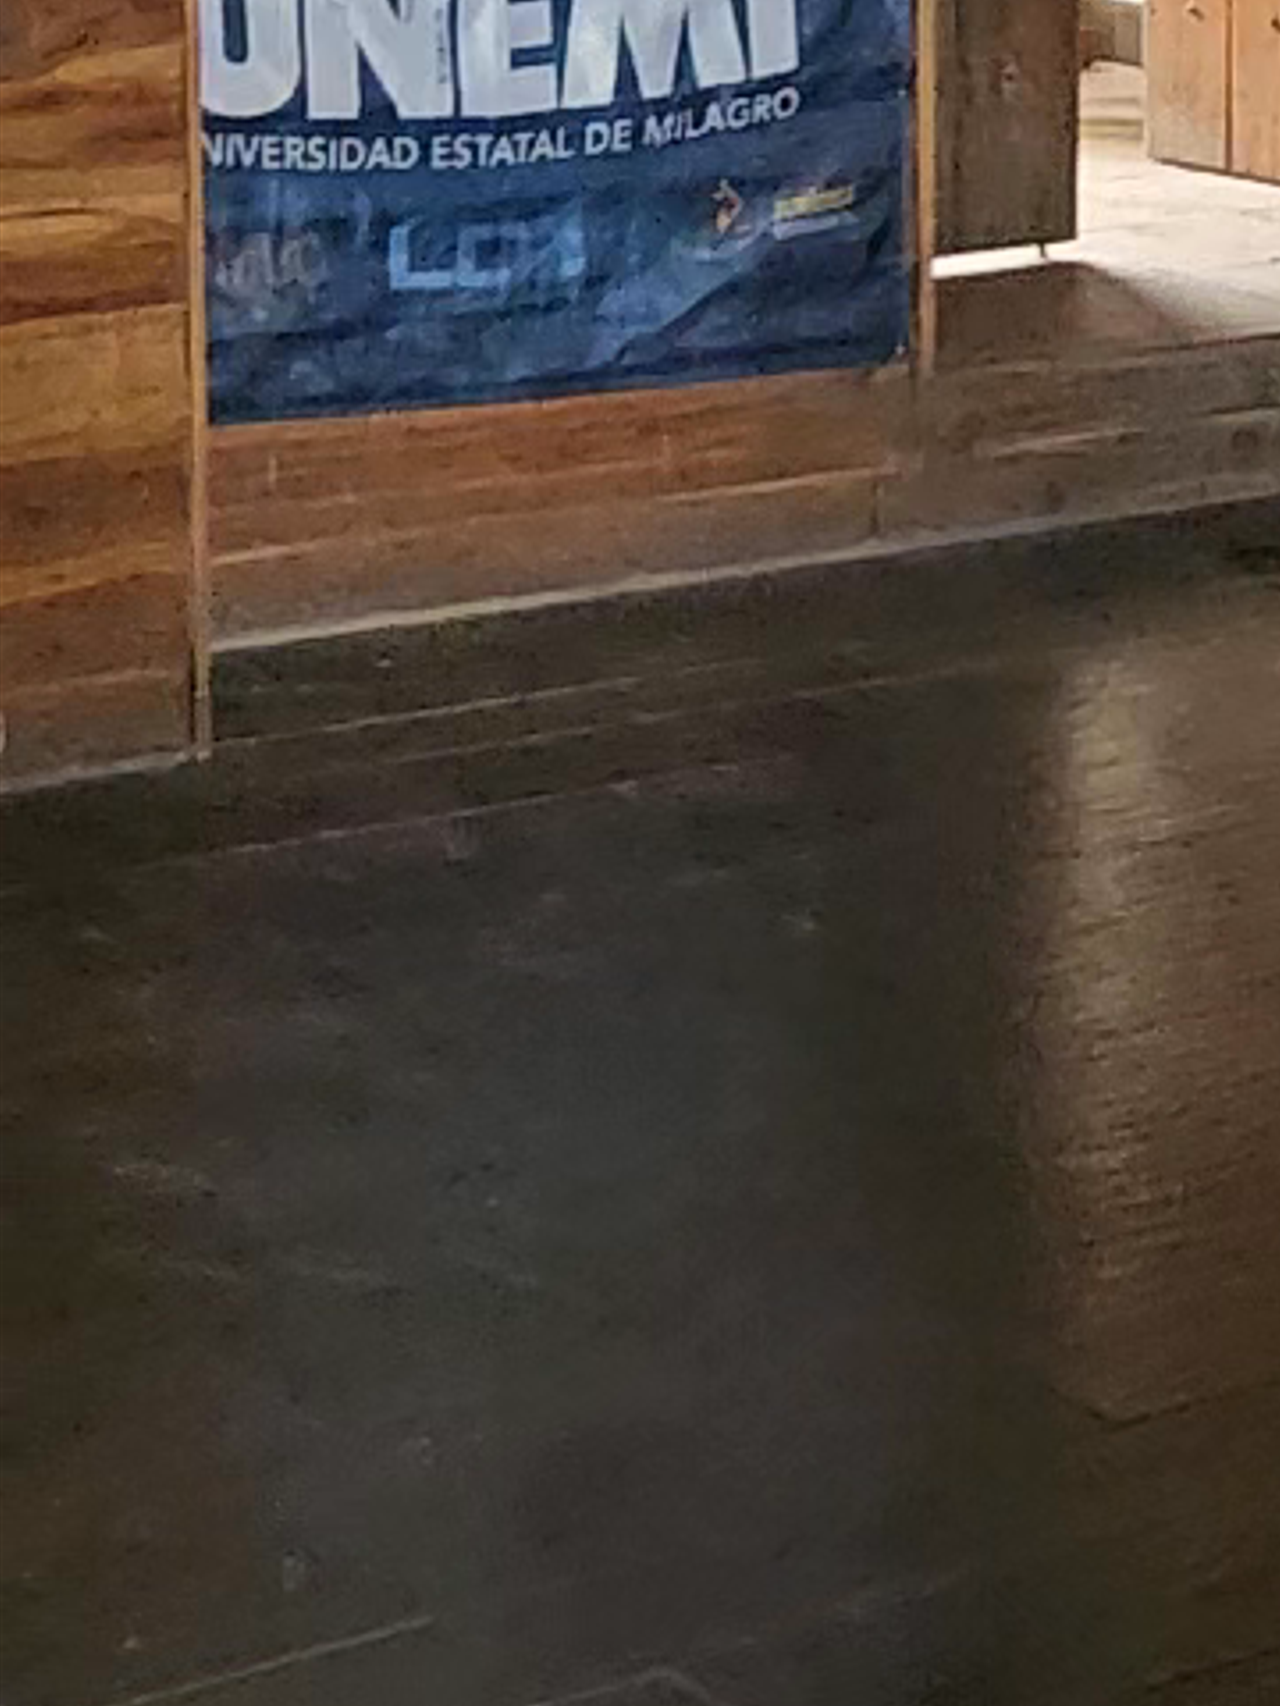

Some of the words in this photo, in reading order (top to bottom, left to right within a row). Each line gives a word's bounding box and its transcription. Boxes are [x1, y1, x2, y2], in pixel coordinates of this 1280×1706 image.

[430, 129, 576, 170] ESTATAL
[585, 118, 633, 154] DE
[643, 86, 801, 150] MILAGRO
